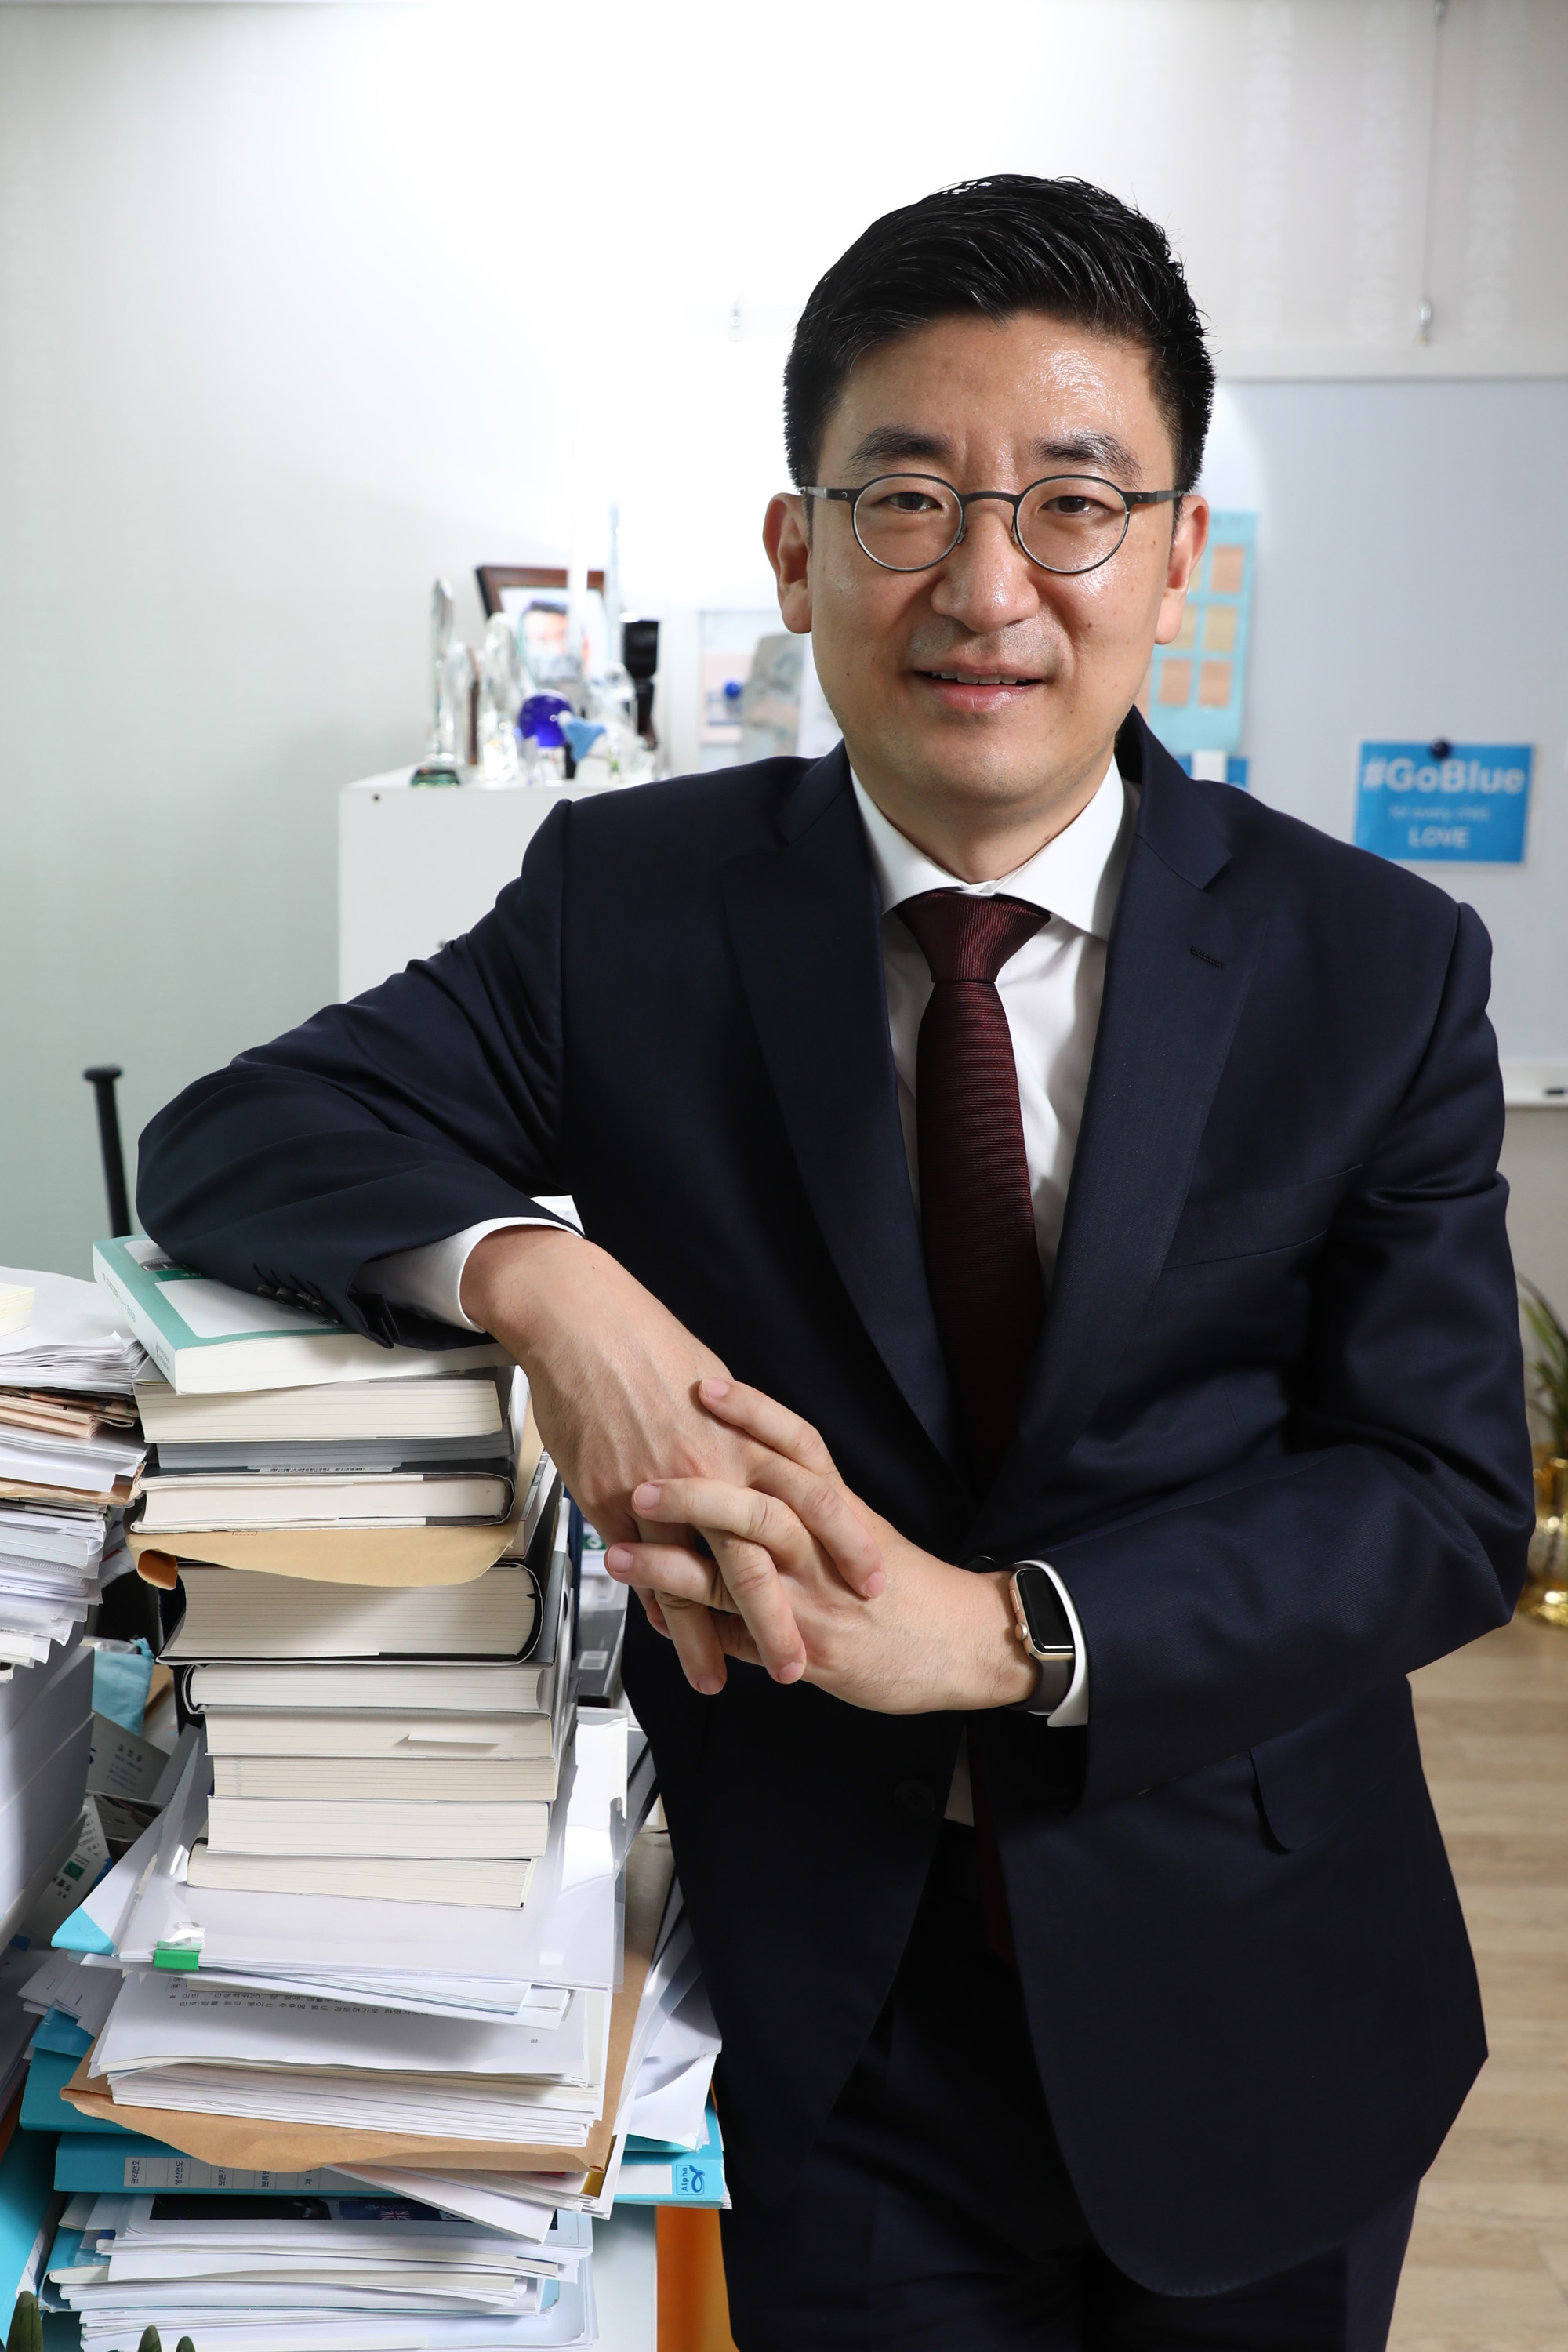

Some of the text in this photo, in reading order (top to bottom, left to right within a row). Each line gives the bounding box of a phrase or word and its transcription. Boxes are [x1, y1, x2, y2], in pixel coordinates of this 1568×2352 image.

[1363, 757, 1526, 795] #GoBlue
[1407, 826, 1471, 849] LOVE
[131, 2160, 140, 2184] 관리번호
[218, 2168, 227, 2186] 보존기
[681, 2167, 689, 2192] Alpha
